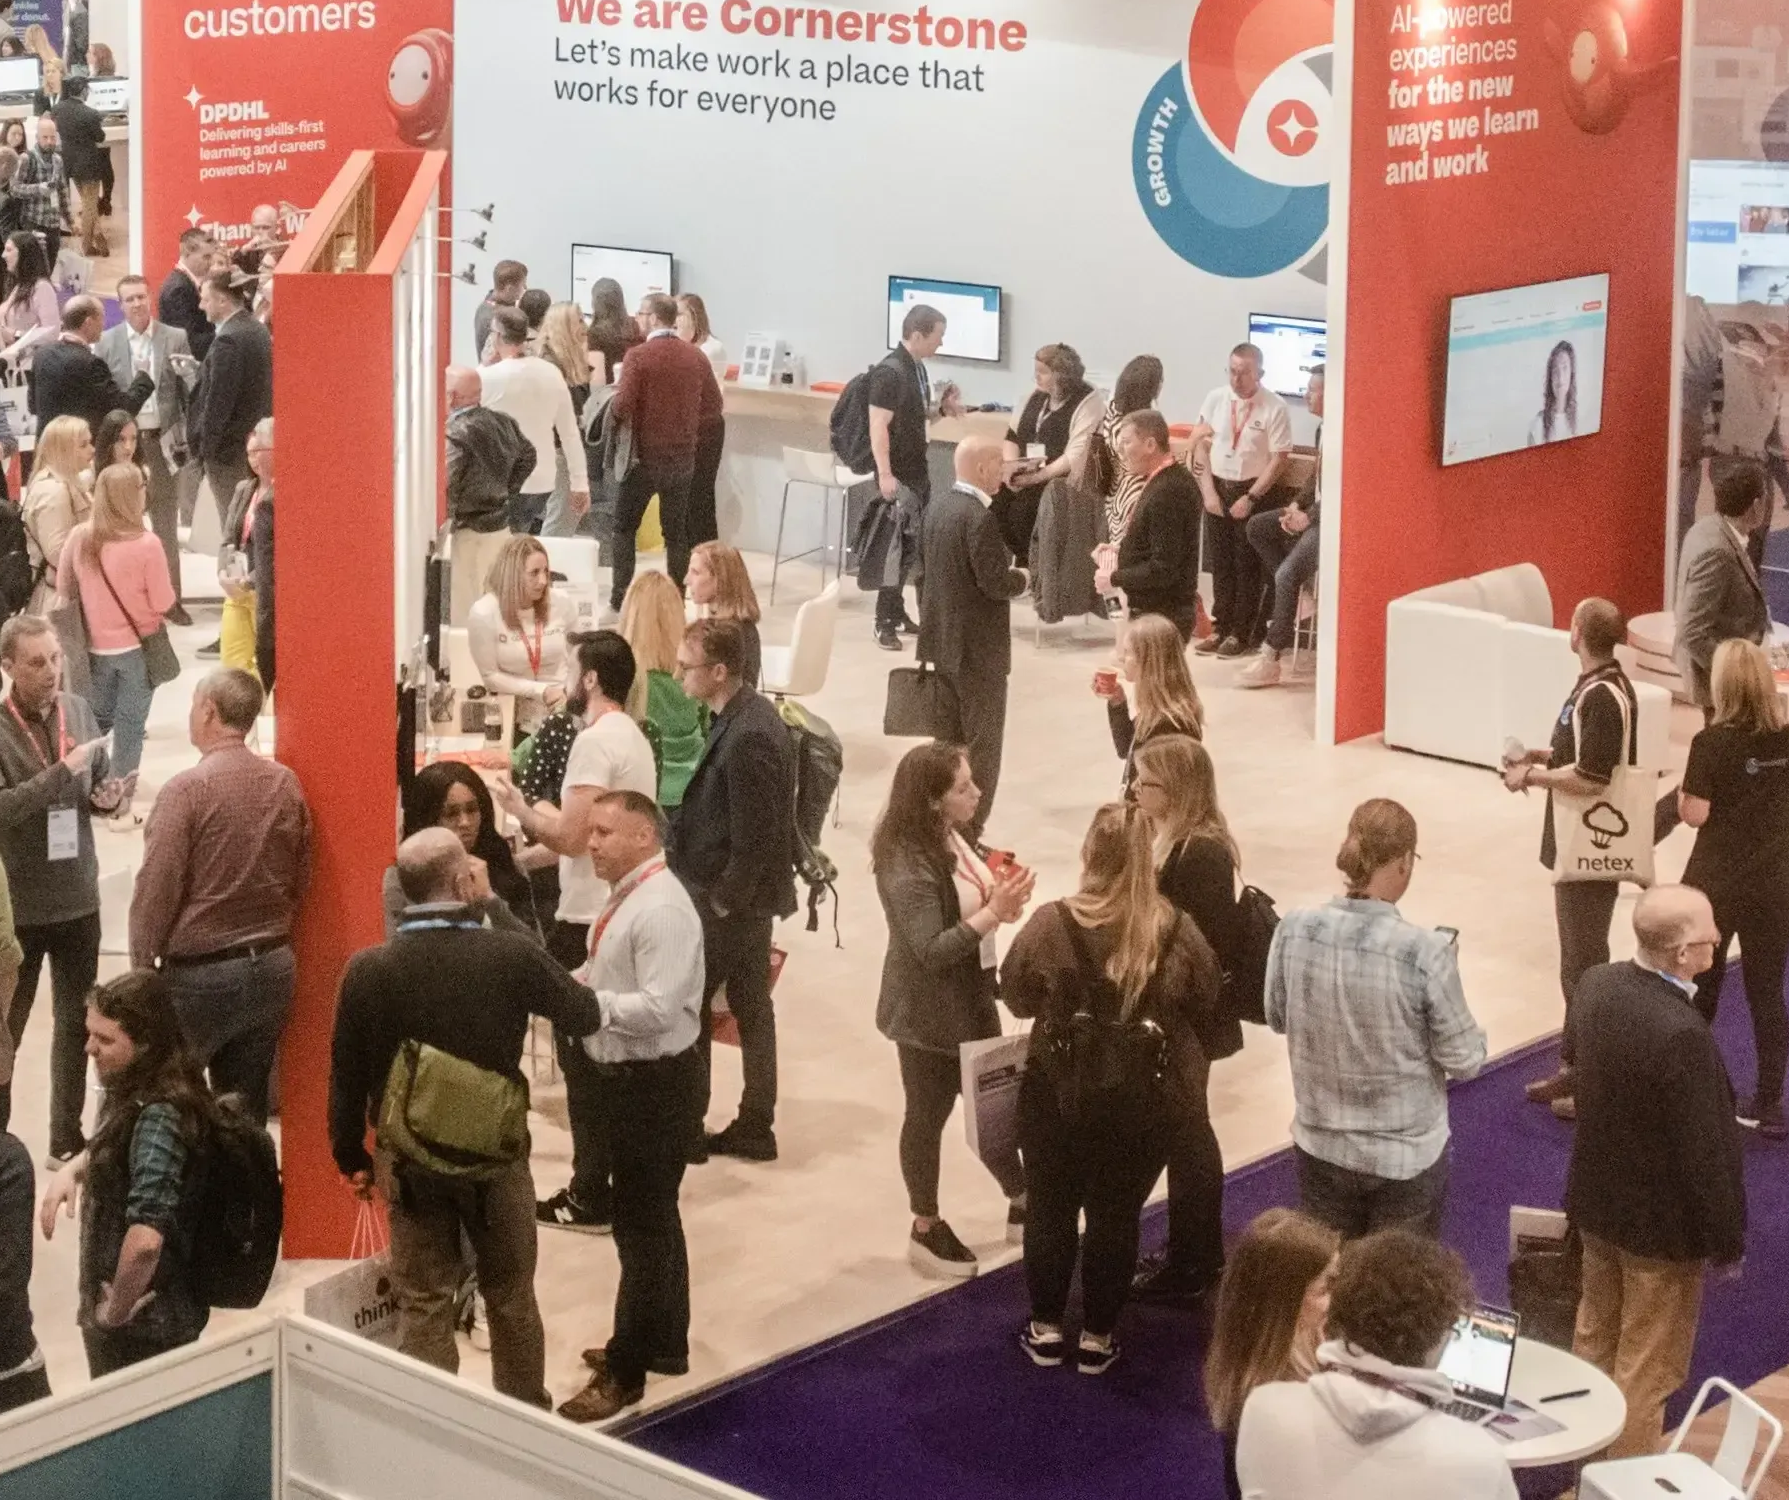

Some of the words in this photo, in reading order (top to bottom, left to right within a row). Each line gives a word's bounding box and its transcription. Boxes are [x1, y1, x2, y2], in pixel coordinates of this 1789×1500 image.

[183, 0, 376, 39] customers
[629, 40, 710, 72] make
[717, 46, 793, 77] work
[800, 59, 817, 78] a
[825, 56, 910, 89] place
[918, 59, 986, 94] that
[1389, 36, 1518, 76] experiences
[554, 76, 640, 108] works
[646, 78, 689, 110] for
[695, 87, 837, 123] everyone
[1388, 79, 1423, 110] for
[1426, 74, 1465, 105] the
[1468, 74, 1514, 101] new
[199, 100, 269, 124] DPDHL
[199, 120, 262, 143] Delivering
[263, 120, 324, 139] skills-first
[1386, 118, 1444, 151] ways
[1448, 116, 1480, 141] we
[1483, 106, 1540, 137] learn
[199, 142, 251, 161] learning
[253, 141, 277, 156] and
[279, 137, 326, 153] careers
[1145, 96, 1179, 208] GROWTH
[1385, 149, 1429, 186] and
[1433, 143, 1489, 179] work
[199, 160, 255, 181] powered
[257, 159, 272, 178] by
[274, 158, 287, 173] AI
[1577, 852, 1635, 873] netex
